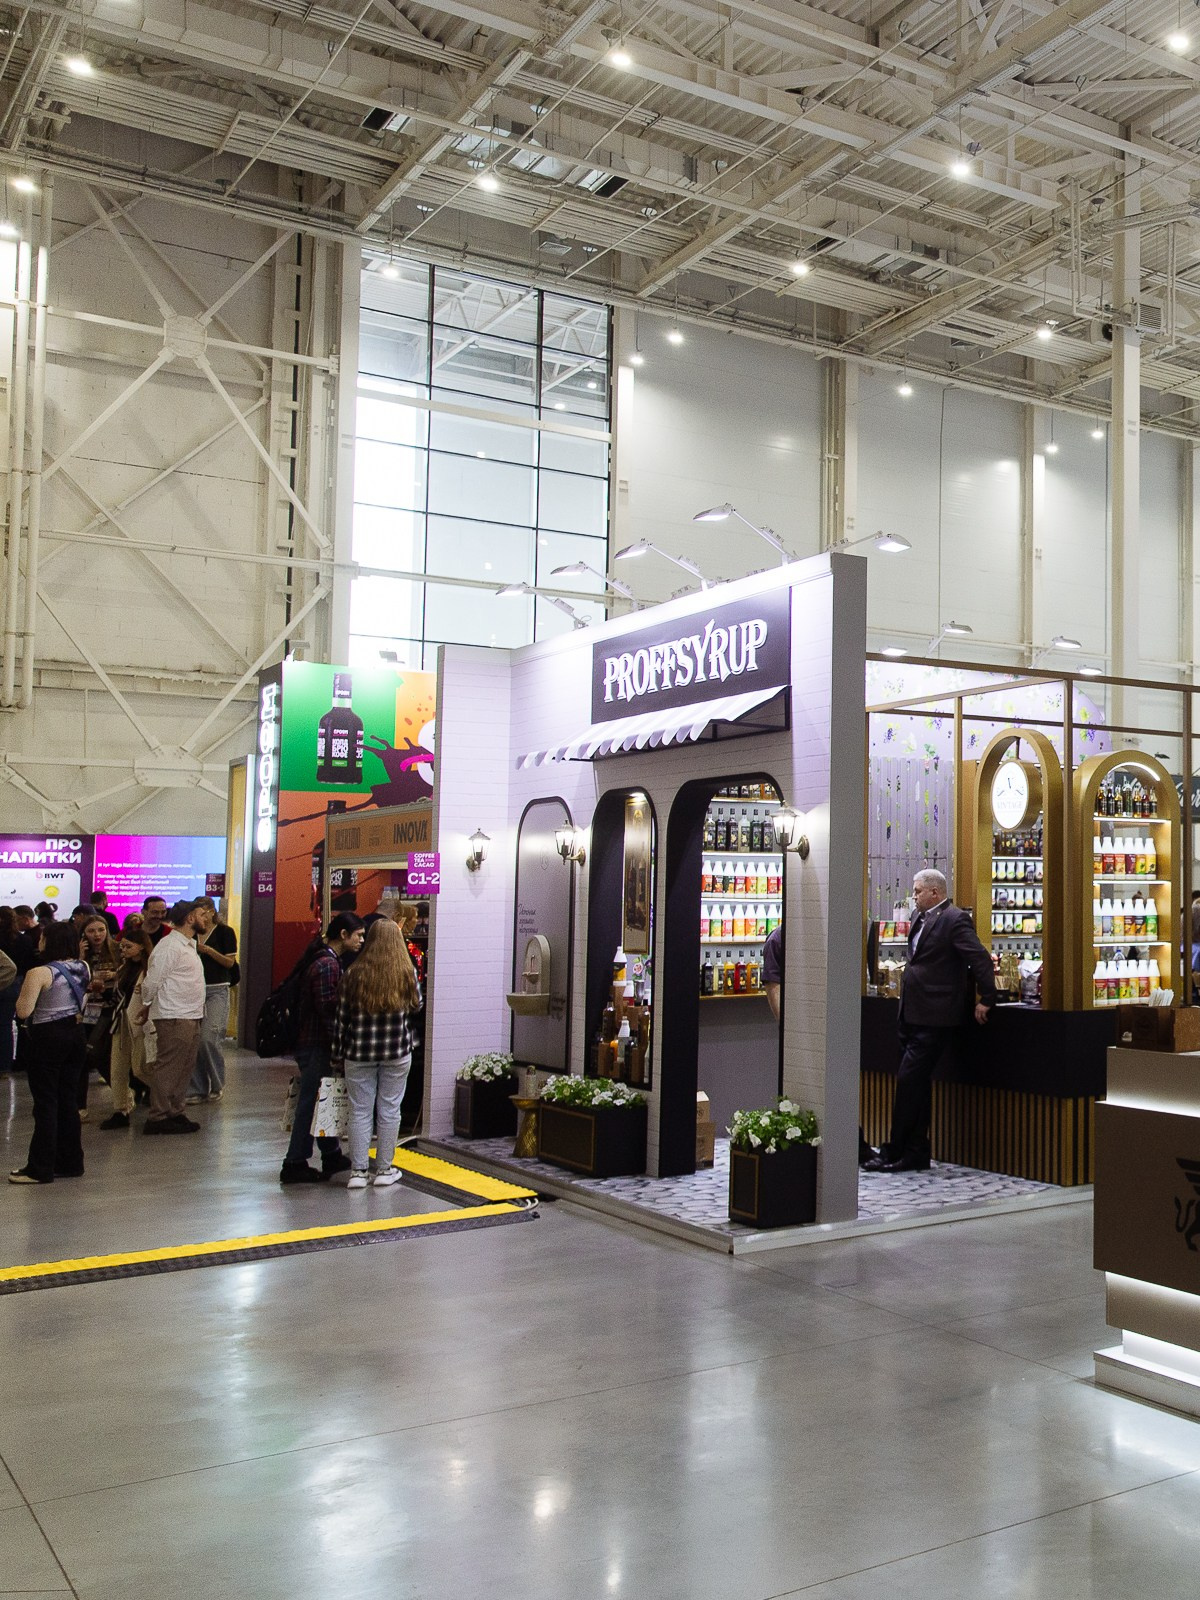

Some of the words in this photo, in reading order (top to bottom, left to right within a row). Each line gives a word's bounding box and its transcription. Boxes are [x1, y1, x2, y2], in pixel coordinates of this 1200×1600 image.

[603, 619, 768, 703] PROFFSYRUP
[46, 839, 82, 850] ПРО
[0, 851, 82, 864] НАПИТКИ
[408, 873, 440, 885] C1-2
[258, 884, 273, 892] B4
